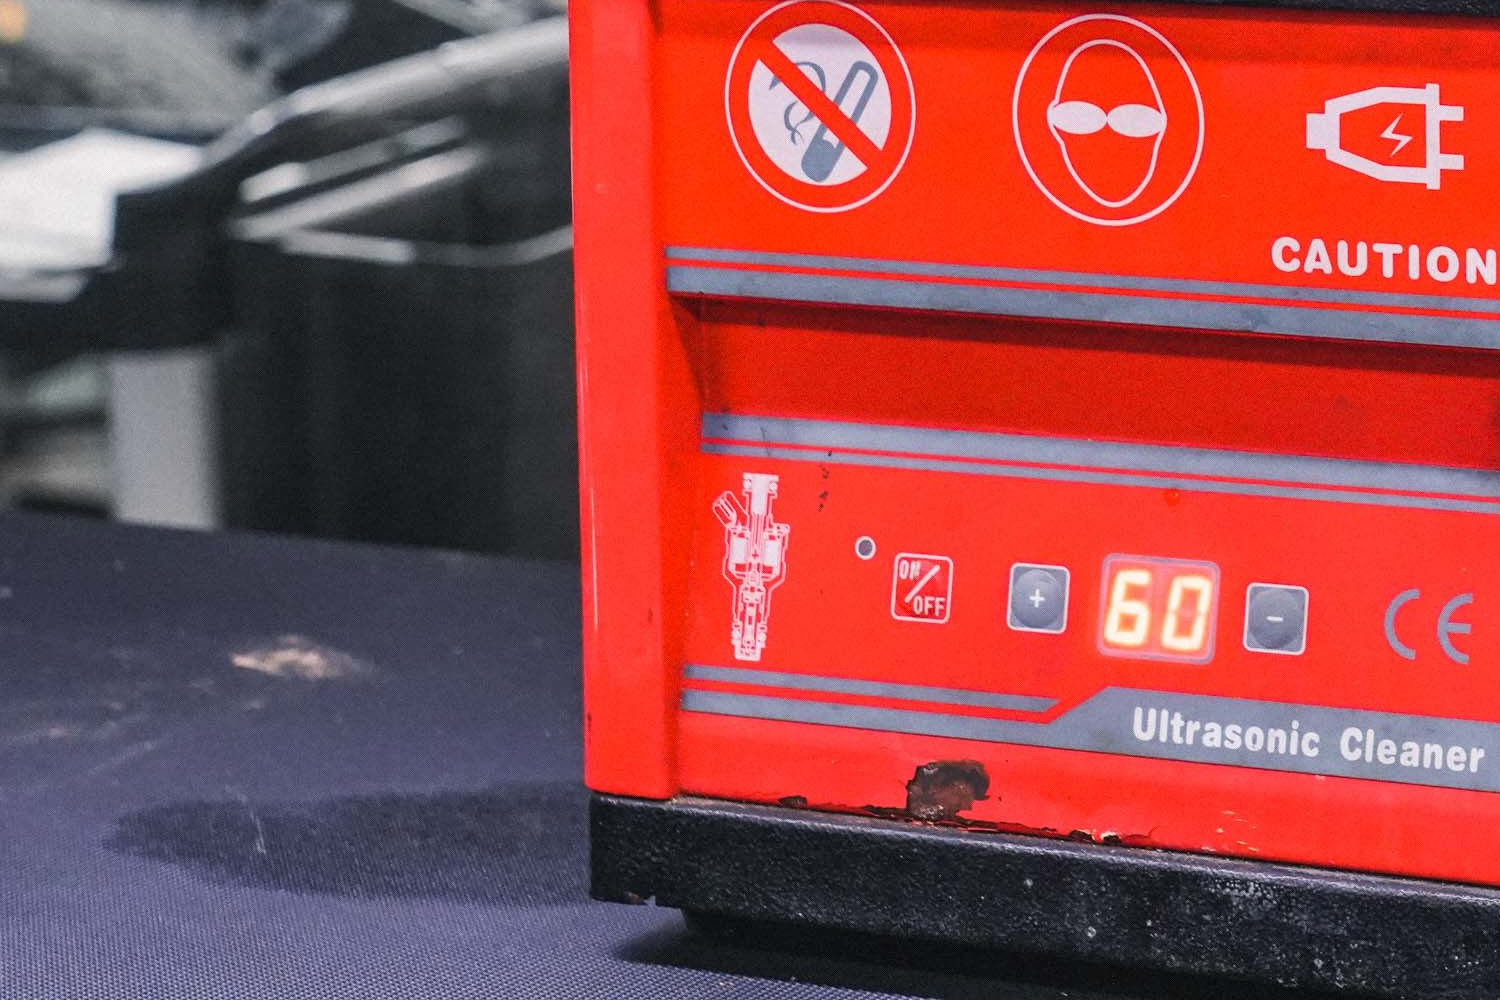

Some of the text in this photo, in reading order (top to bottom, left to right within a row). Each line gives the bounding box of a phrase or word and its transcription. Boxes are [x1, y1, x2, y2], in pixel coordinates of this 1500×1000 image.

[1271, 236, 1497, 285] CAUTION
[899, 560, 921, 580] ON
[912, 596, 946, 618] OFF
[1104, 569, 1214, 651] 60
[1384, 588, 1473, 664] CE
[1132, 706, 1485, 773] Ultrasonic Cleaner
